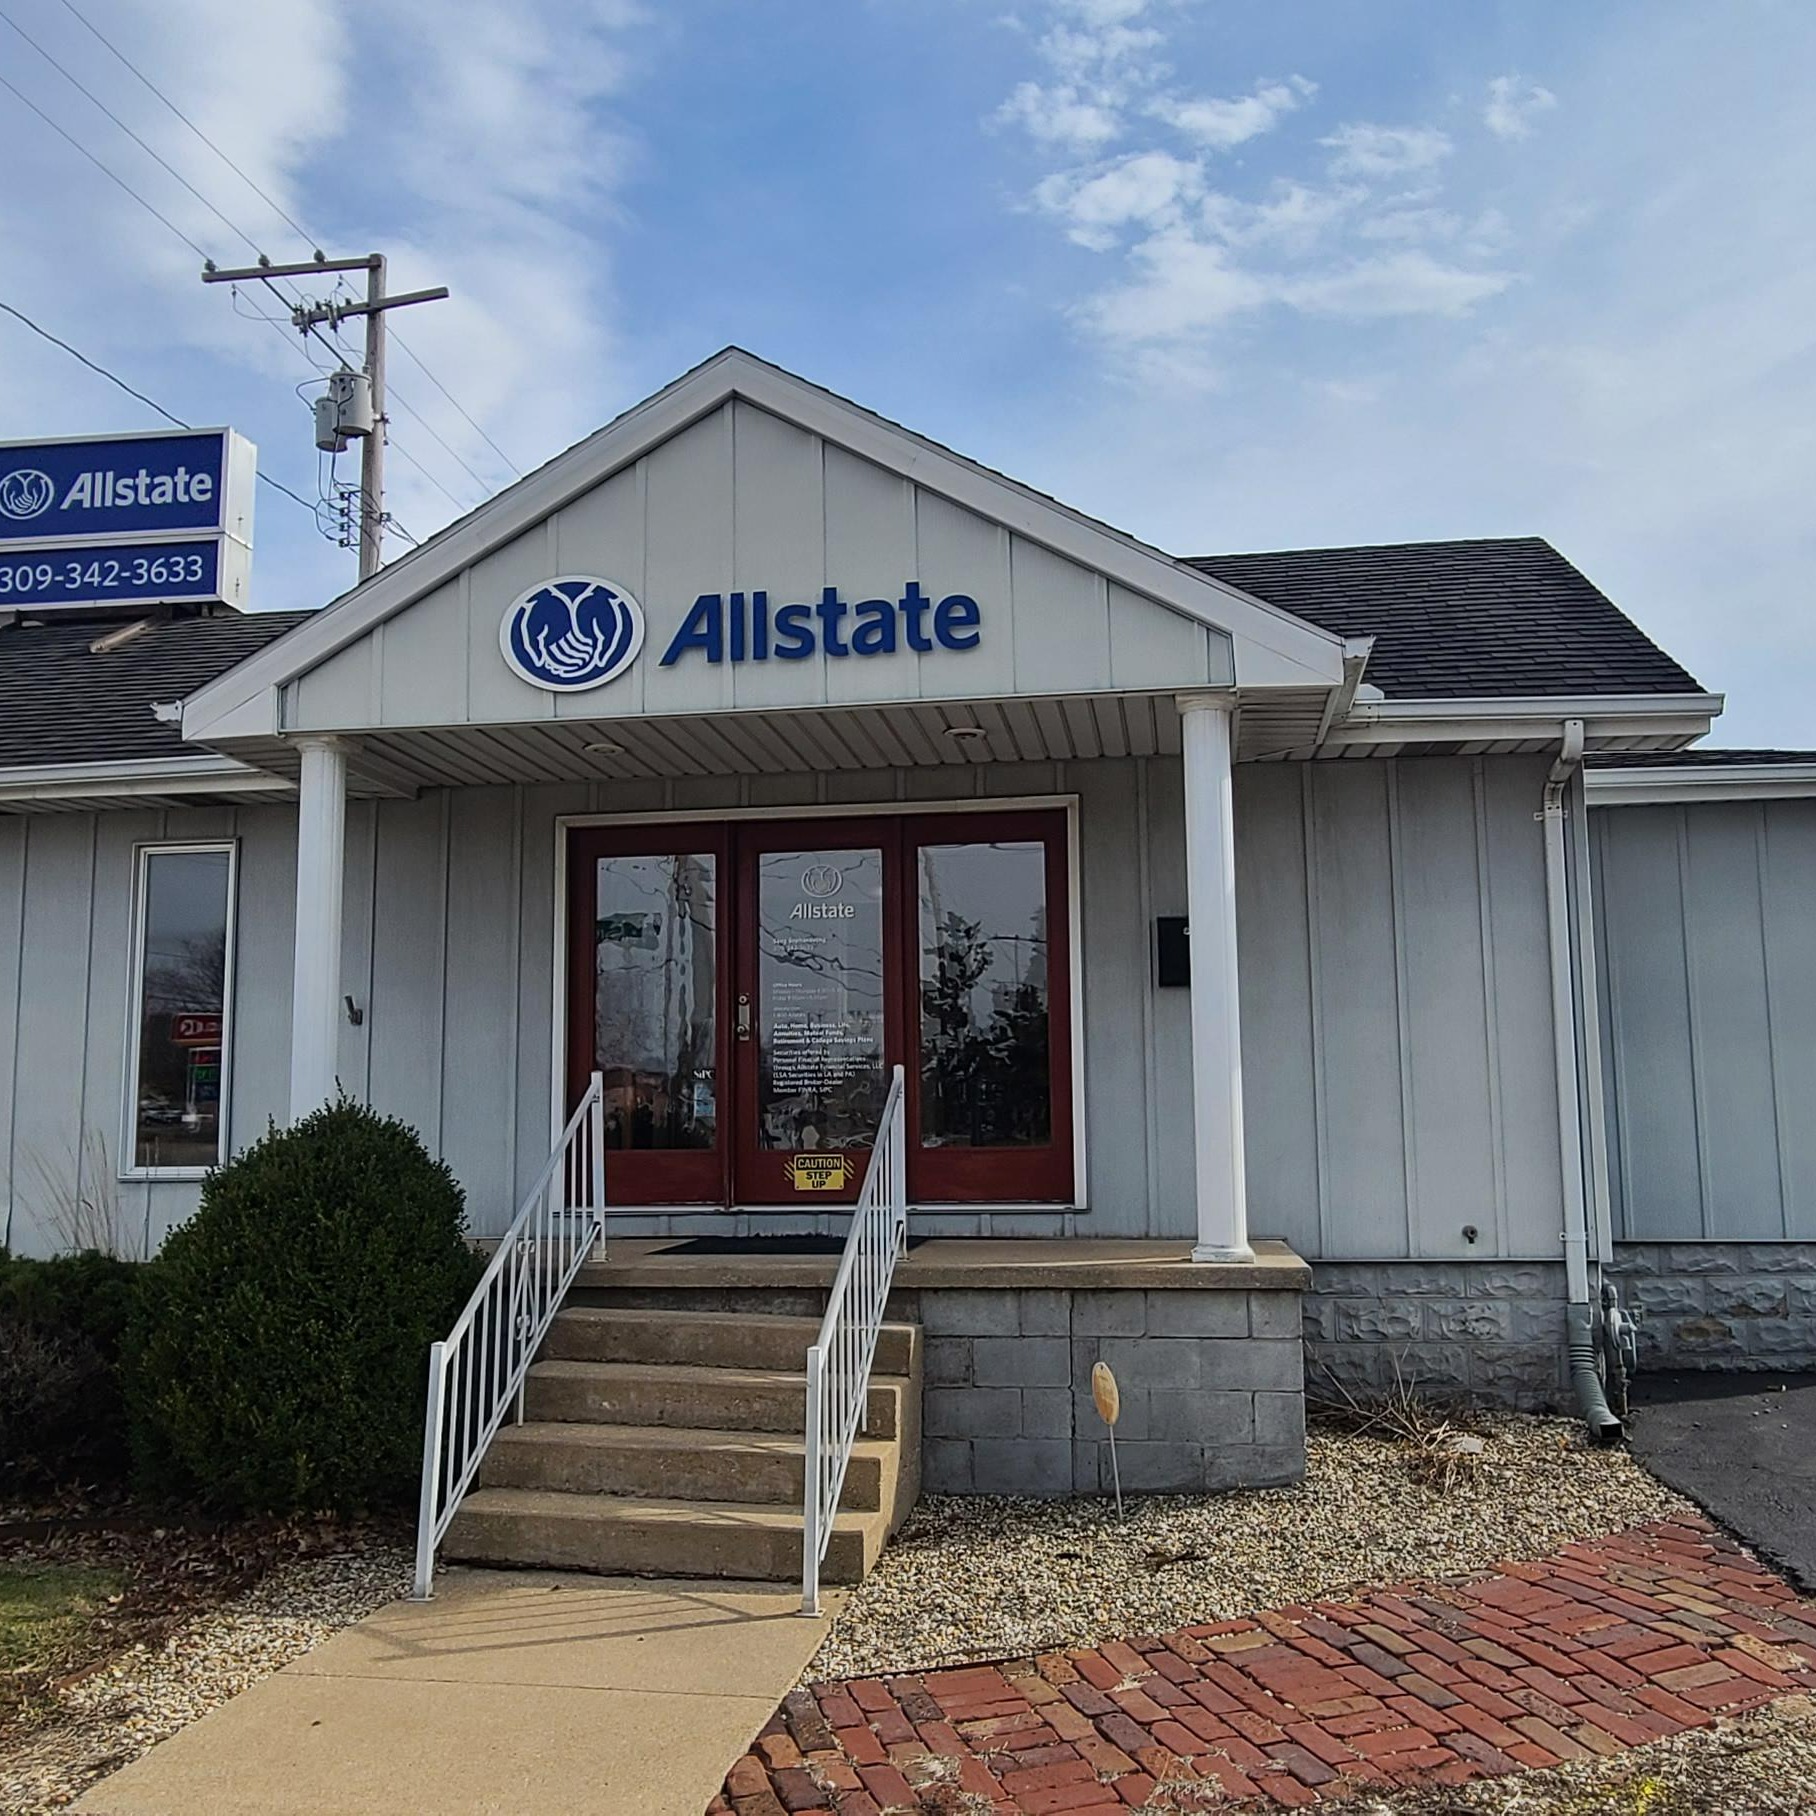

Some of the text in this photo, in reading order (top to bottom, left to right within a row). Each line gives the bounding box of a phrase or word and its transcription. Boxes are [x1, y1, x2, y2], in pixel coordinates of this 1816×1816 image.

[60, 466, 213, 510] Allstate
[0, 555, 203, 593] 309-342-3633
[658, 580, 982, 667] Allstate
[789, 903, 855, 919] Allstate
[773, 1063, 796, 1071] through
[773, 1071, 788, 1079] (LSA
[773, 1079, 803, 1087] Registered
[797, 1158, 841, 1169] CAUTION
[806, 1171, 832, 1180] STEP
[811, 1180, 826, 1189] UP
